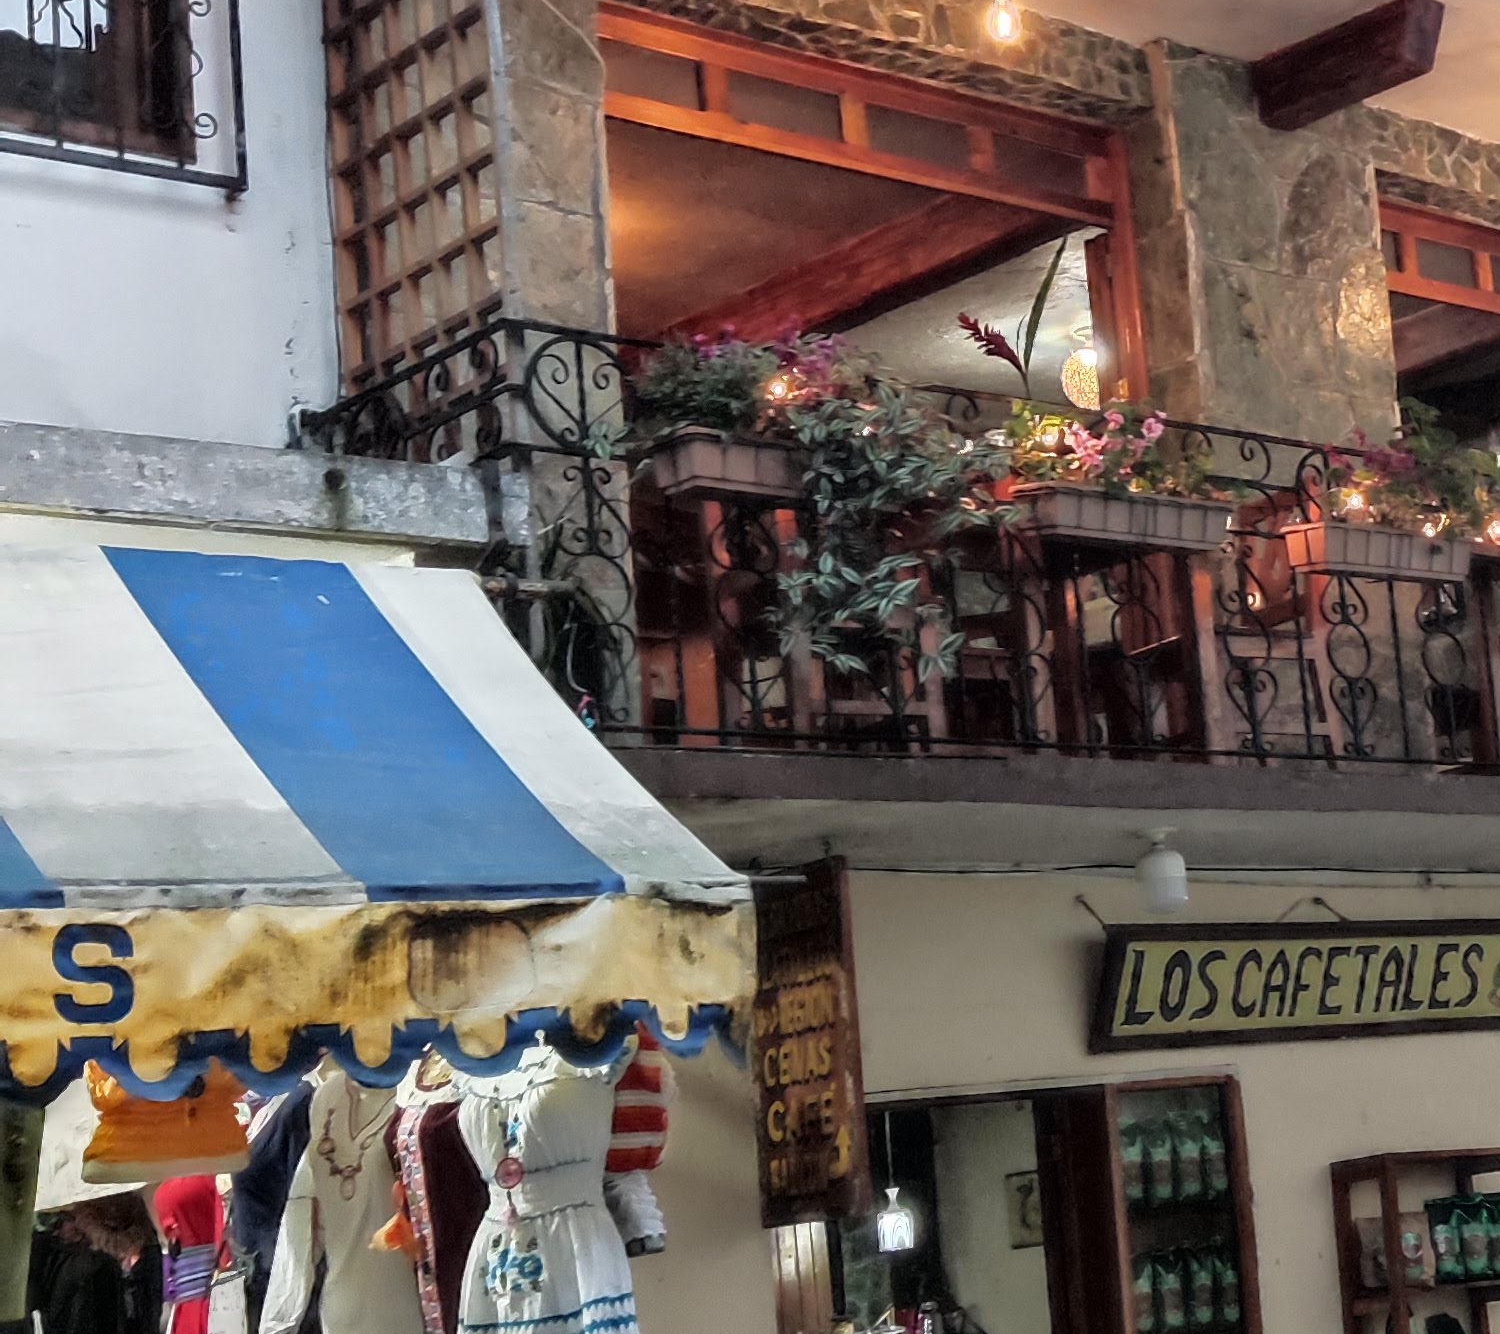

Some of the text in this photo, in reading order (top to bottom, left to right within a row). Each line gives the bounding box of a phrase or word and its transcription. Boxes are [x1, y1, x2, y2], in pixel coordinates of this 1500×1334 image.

[52, 923, 135, 1025] S
[1119, 942, 1484, 1027] LOS CAFETALES
